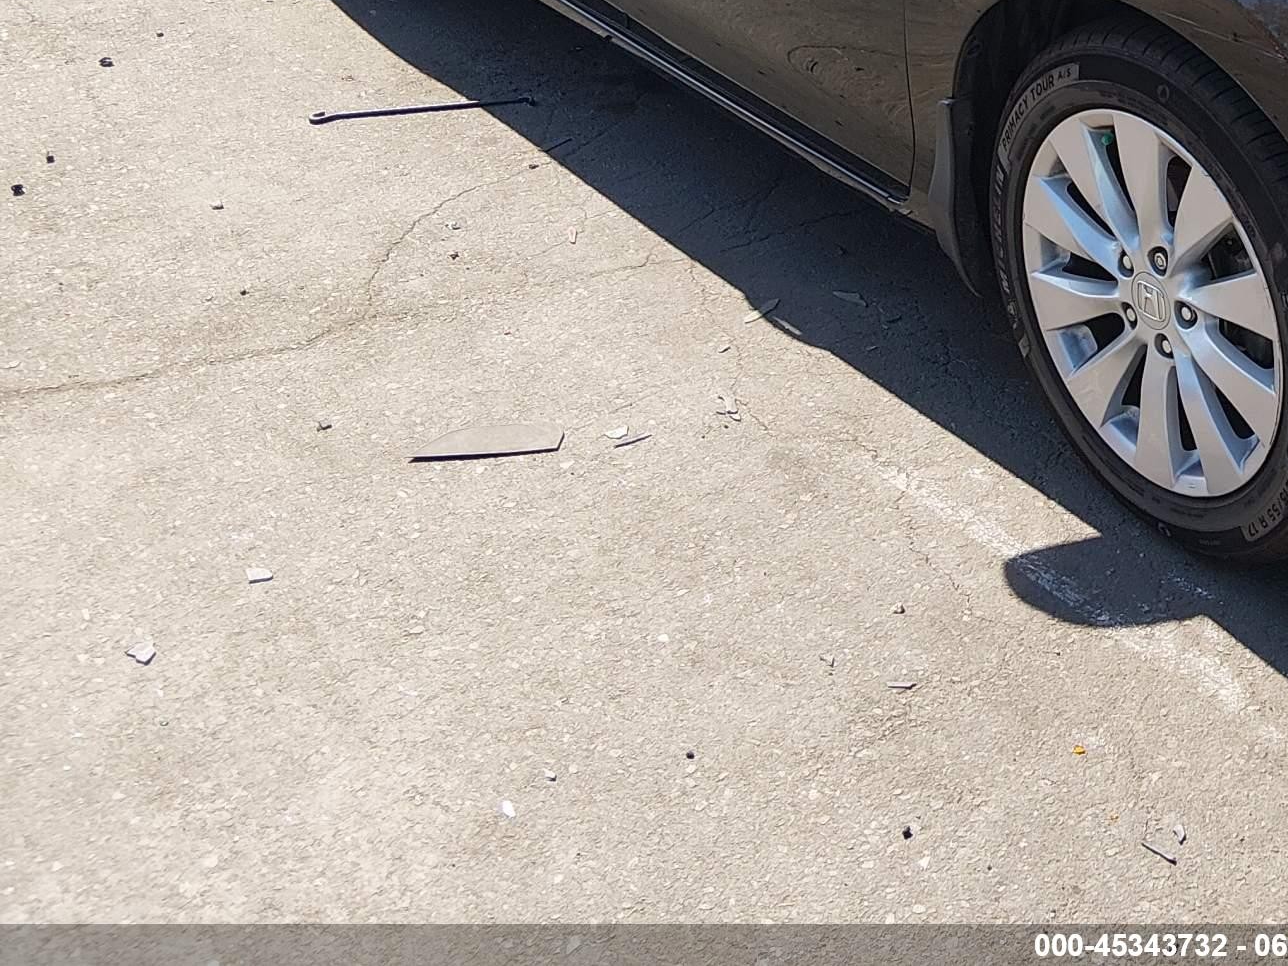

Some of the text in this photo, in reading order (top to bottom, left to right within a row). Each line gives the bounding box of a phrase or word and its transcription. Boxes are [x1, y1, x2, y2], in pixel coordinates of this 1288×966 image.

[1002, 67, 1071, 152] PRIMACY TOUR A/S
[1248, 521, 1260, 537] 17
